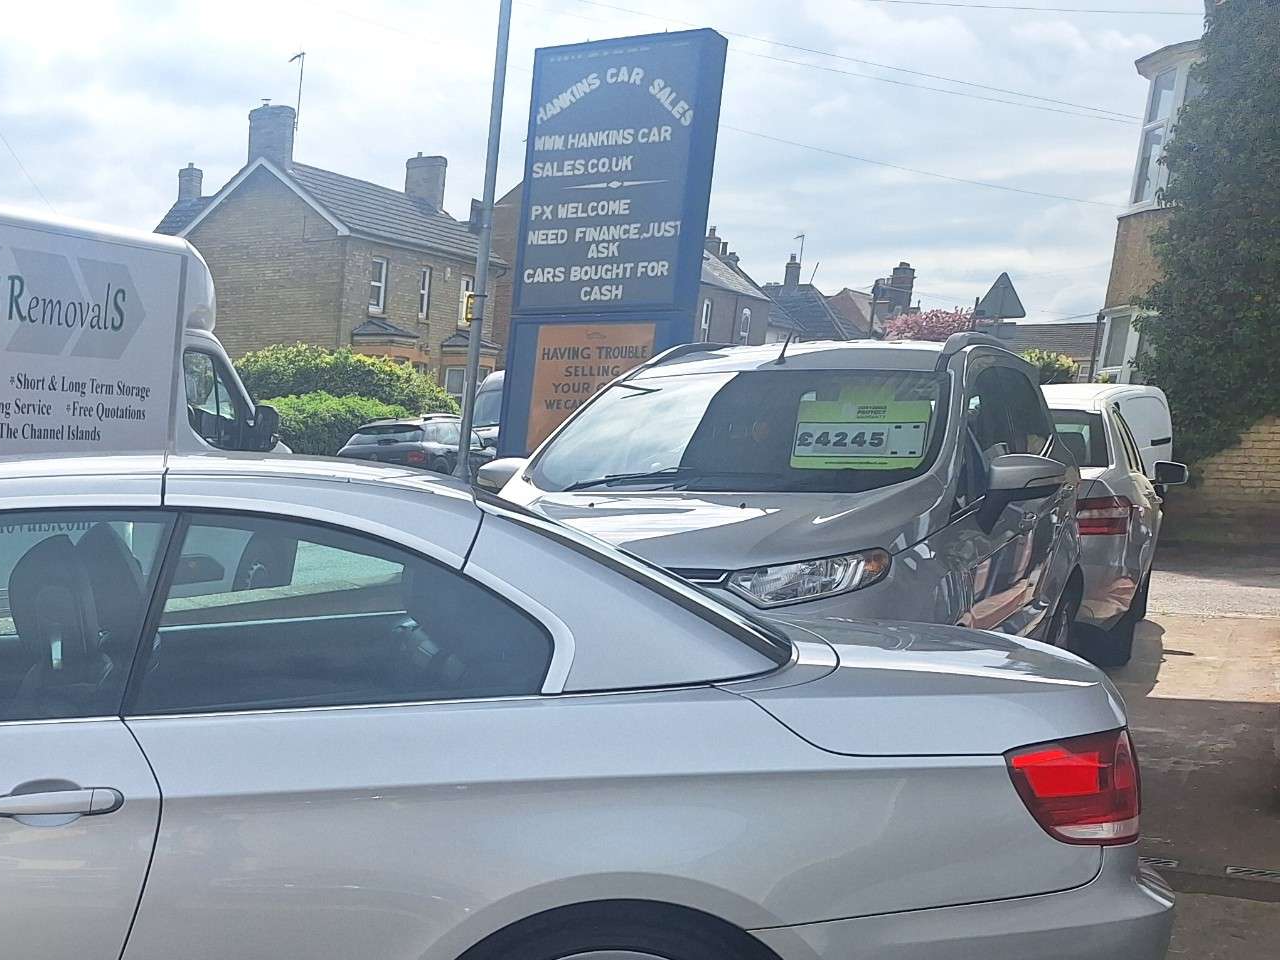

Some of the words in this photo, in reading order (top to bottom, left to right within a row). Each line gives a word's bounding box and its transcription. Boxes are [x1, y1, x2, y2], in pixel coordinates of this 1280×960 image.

[536, 72, 601, 125] HANKINS
[606, 66, 644, 85] CAR
[649, 78, 694, 126] SALES
[638, 126, 672, 143] CAR
[532, 155, 633, 178] SALES.CO.UK
[531, 205, 552, 220] PX
[557, 200, 630, 218] WELCOME
[527, 229, 568, 245] NEED
[587, 242, 619, 259] ASK
[523, 266, 565, 283] CARS
[570, 263, 634, 281] BOUGHT
[637, 261, 668, 277] FOR
[580, 284, 623, 301] CASH
[7, 274, 126, 331] RemovalS
[542, 347, 591, 360] HAVING
[596, 346, 648, 359] TROUBLE
[564, 365, 620, 377] SELLING
[48, 376, 58, 392] &
[61, 376, 86, 397] Long
[89, 378, 114, 395] Term
[116, 380, 150, 400] Storage
[552, 382, 590, 393] YOUR
[14, 398, 52, 416] Service
[96, 402, 146, 421] Quotations
[21, 422, 64, 441] Channel
[67, 424, 100, 442] Islands
[797, 431, 884, 447] £4245
